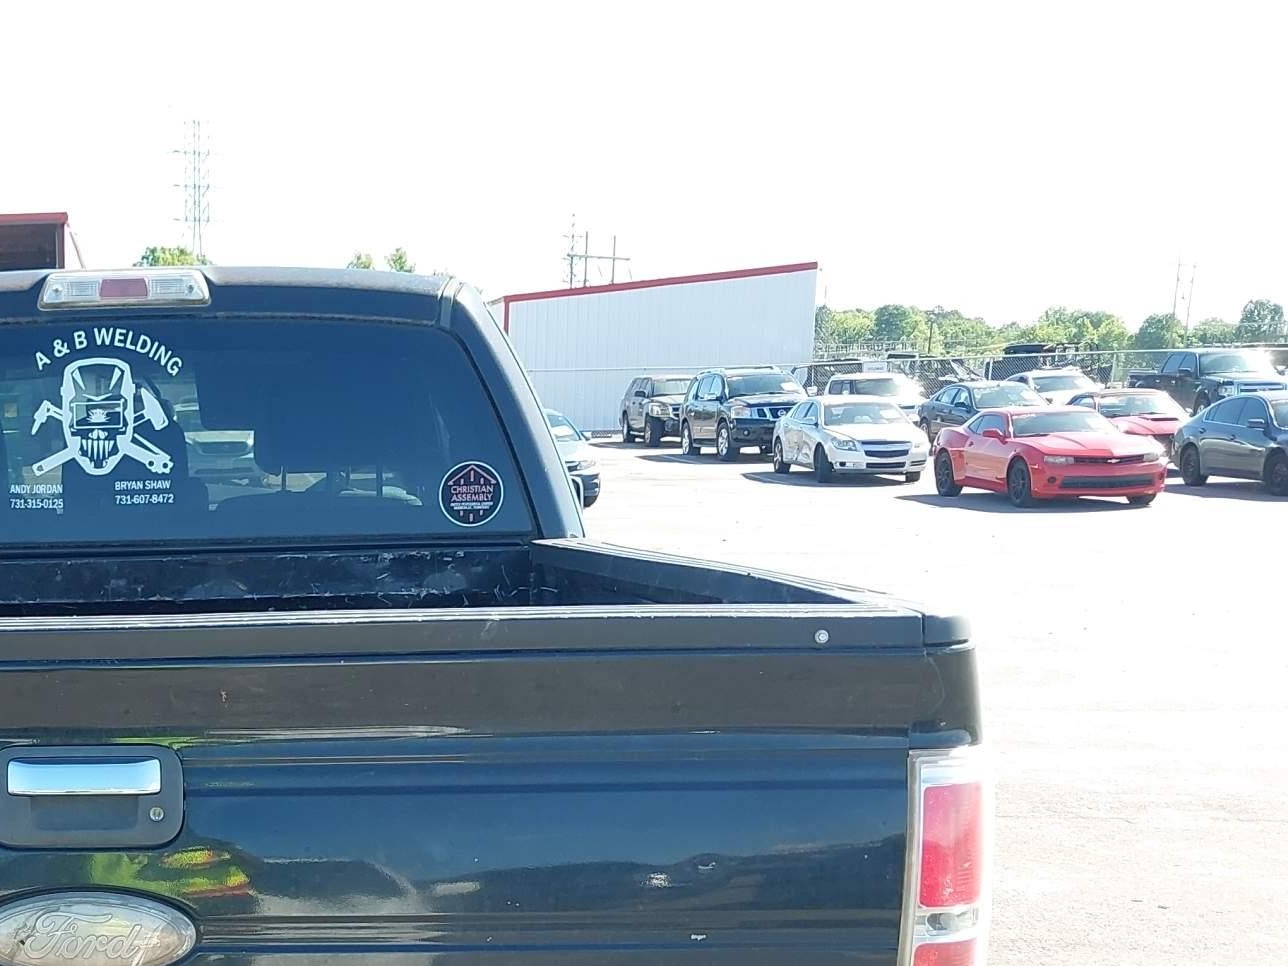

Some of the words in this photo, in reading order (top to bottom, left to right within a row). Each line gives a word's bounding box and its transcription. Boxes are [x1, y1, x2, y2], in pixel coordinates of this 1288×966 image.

[34, 351, 51, 371] A
[52, 339, 70, 357] &
[73, 330, 88, 350] B
[93, 327, 183, 377] WELDING
[9, 484, 31, 494] ANDY
[31, 484, 63, 494] JORDAN
[114, 481, 143, 491] BRYAN
[144, 479, 171, 490] SHAW
[450, 485, 494, 494] CHRISTIAN
[114, 493, 174, 504] 731-607-8472
[450, 493, 492, 502] ASSEMBLY
[10, 498, 64, 509] 731-315-0125
[23, 912, 140, 960] Ford
